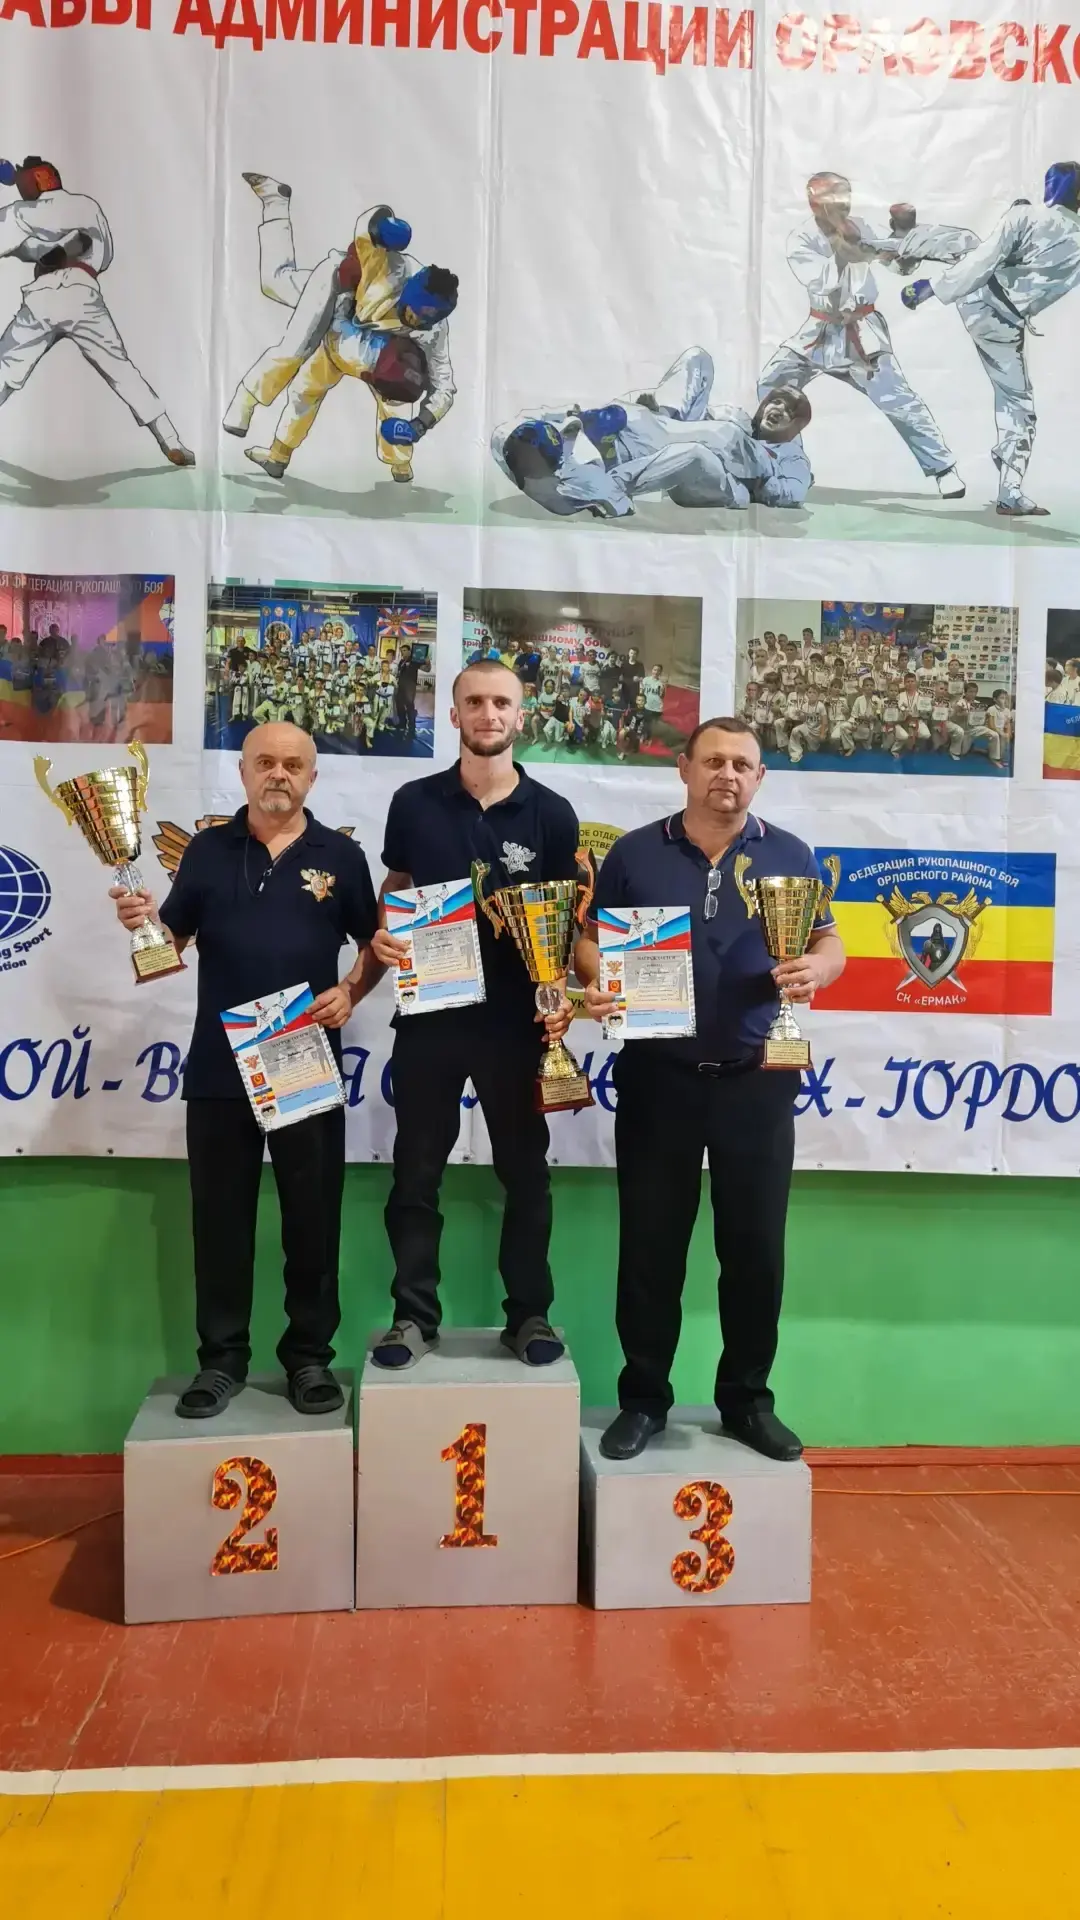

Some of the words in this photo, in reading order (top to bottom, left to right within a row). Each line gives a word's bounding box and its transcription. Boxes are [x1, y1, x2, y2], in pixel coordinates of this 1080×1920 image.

[173, 0, 753, 76] АДМИНИСТРАЦИИ
[775, 11, 1080, 84] ОРЛОВСК
[143, 580, 165, 595] БОЯ
[848, 857, 915, 883] ФЕДЕРАЦИЯ
[917, 856, 997, 877] РУКОПАШНОГО
[998, 872, 1020, 888] БОЯ
[876, 870, 949, 887] ОРЛОВСКОГО
[950, 871, 993, 890] РАЙОНА
[13, 927, 52, 953] Sport
[896, 991, 912, 1003] СК
[914, 994, 967, 1006] «ЕРМАК»
[438, 1423, 498, 1548] 1
[211, 1456, 279, 1576] 2
[671, 1480, 735, 1593] 3
